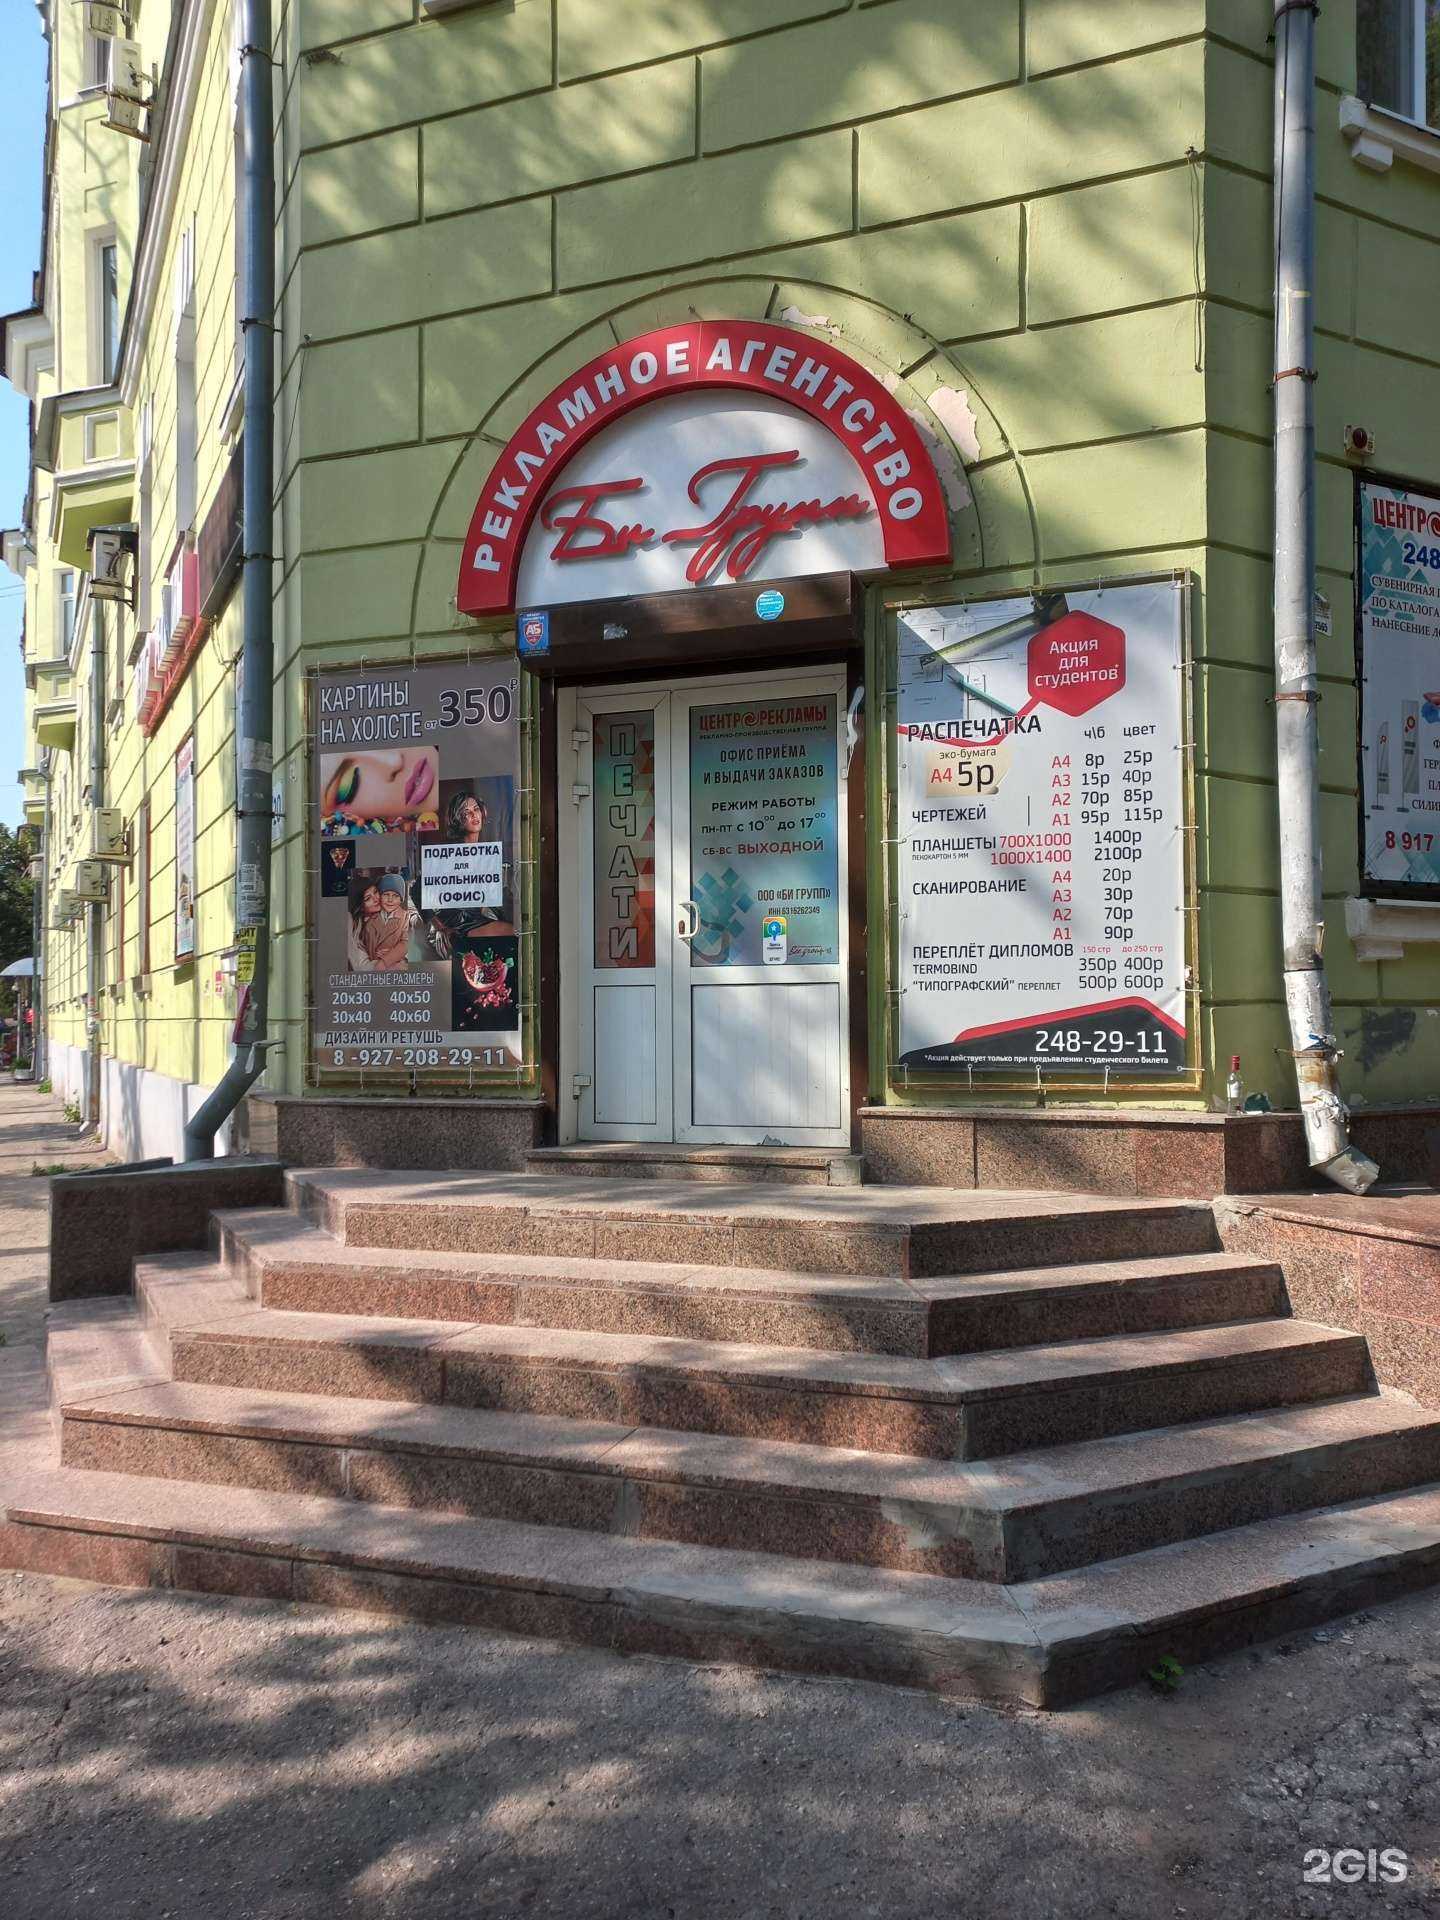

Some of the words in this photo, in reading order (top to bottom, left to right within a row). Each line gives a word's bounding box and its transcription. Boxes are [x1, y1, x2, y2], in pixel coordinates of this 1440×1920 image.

[473, 340, 691, 574] РЕКЛАМНОЕ
[705, 338, 923, 521] АГЕНТСТВО
[1372, 497, 1427, 533] ЦЕНТР
[1371, 575, 1436, 598] СУВЕНИРНАЯ
[1371, 595, 1388, 608] ПО
[1371, 616, 1431, 637] НАНЕСЕНИЕ
[1050, 639, 1099, 654] Акция
[1059, 656, 1089, 670] для
[320, 680, 409, 712] КАРТИНЫ
[320, 719, 345, 744] НА
[351, 711, 422, 742] ХОЛСТЕ
[425, 720, 437, 730] от
[908, 715, 1042, 742] РАСПЕЧАТКА
[1123, 724, 1156, 738] цвет
[720, 748, 753, 762] ОФИС
[939, 748, 997, 760] эко-бумага
[1052, 755, 1071, 769] А4
[1085, 753, 1105, 768] 8р
[1124, 750, 1153, 765] 25р
[704, 772, 710, 784] И
[714, 769, 765, 784] ВЫДАЧИ
[769, 765, 824, 780] ЗАКАЗОВ
[931, 769, 952, 784] А4
[958, 760, 994, 792] 5р
[1052, 775, 1071, 788] А3
[1082, 772, 1110, 787] 15р
[1122, 769, 1152, 784] 40р
[712, 800, 758, 811] РЕЖИМ
[762, 798, 815, 808] РАБОТЫ
[1052, 793, 1071, 807] А2
[1081, 791, 1109, 806] 70р
[1124, 789, 1153, 804] 85р
[912, 804, 986, 823] ЧЕРТЕЖЕЙ
[1052, 813, 1071, 826] А1
[1081, 810, 1109, 825] 95р
[1124, 808, 1163, 823] 115р
[608, 723, 639, 960] ПЕЧАТИ
[738, 837, 824, 854] ВЫХОДНОЙ
[912, 837, 996, 852] ПЛАНШЕТЫ
[1094, 830, 1142, 846] 1400р
[1385, 830, 1396, 849] 8
[1401, 831, 1434, 852] 917
[424, 845, 500, 859] ПОДРАБОТКА
[1094, 847, 1142, 863] 2100р
[424, 873, 500, 886] ШКОЛЬНИКОВ
[1052, 870, 1072, 883] А4
[1102, 868, 1132, 882] 20р
[758, 890, 774, 901] ООО
[912, 879, 1027, 896] СКАНИРОВАНИЕ
[1052, 889, 1072, 902] А3
[1104, 888, 1133, 902] 30р
[439, 891, 485, 904] (ОФИС)
[1052, 908, 1072, 921] А2
[1104, 907, 1133, 922] 70р
[1052, 928, 1072, 940] А1
[1104, 926, 1133, 941] 90р
[913, 943, 986, 959] ПЕРЕПЛЁТ
[989, 943, 1074, 959] ДИПЛОМОВ
[1098, 946, 1111, 954] стр
[1122, 946, 1132, 954] до
[1150, 945, 1163, 953] стр
[913, 964, 977, 975] TERMOBIND
[1079, 957, 1117, 972] 350р
[1124, 957, 1163, 972] 400р
[329, 974, 391, 987] СТАНДАРТНЫЕ
[393, 973, 434, 985] РАЗМЕРЫ
[1018, 982, 1061, 990] ПЕРЕПЛЕТ
[1079, 975, 1117, 991] 500р
[1124, 975, 1164, 991] 600р
[325, 1028, 376, 1046] ДИЗАЙН
[379, 1032, 388, 1044] И
[392, 1030, 443, 1044] РЕТУШЬ
[1035, 1030, 1167, 1054] 248-29-11
[334, 1050, 344, 1065] 8
[950, 1055, 986, 1063] действует
[1085, 1056, 1139, 1064] студенческого
[1141, 1055, 1169, 1064] билета
